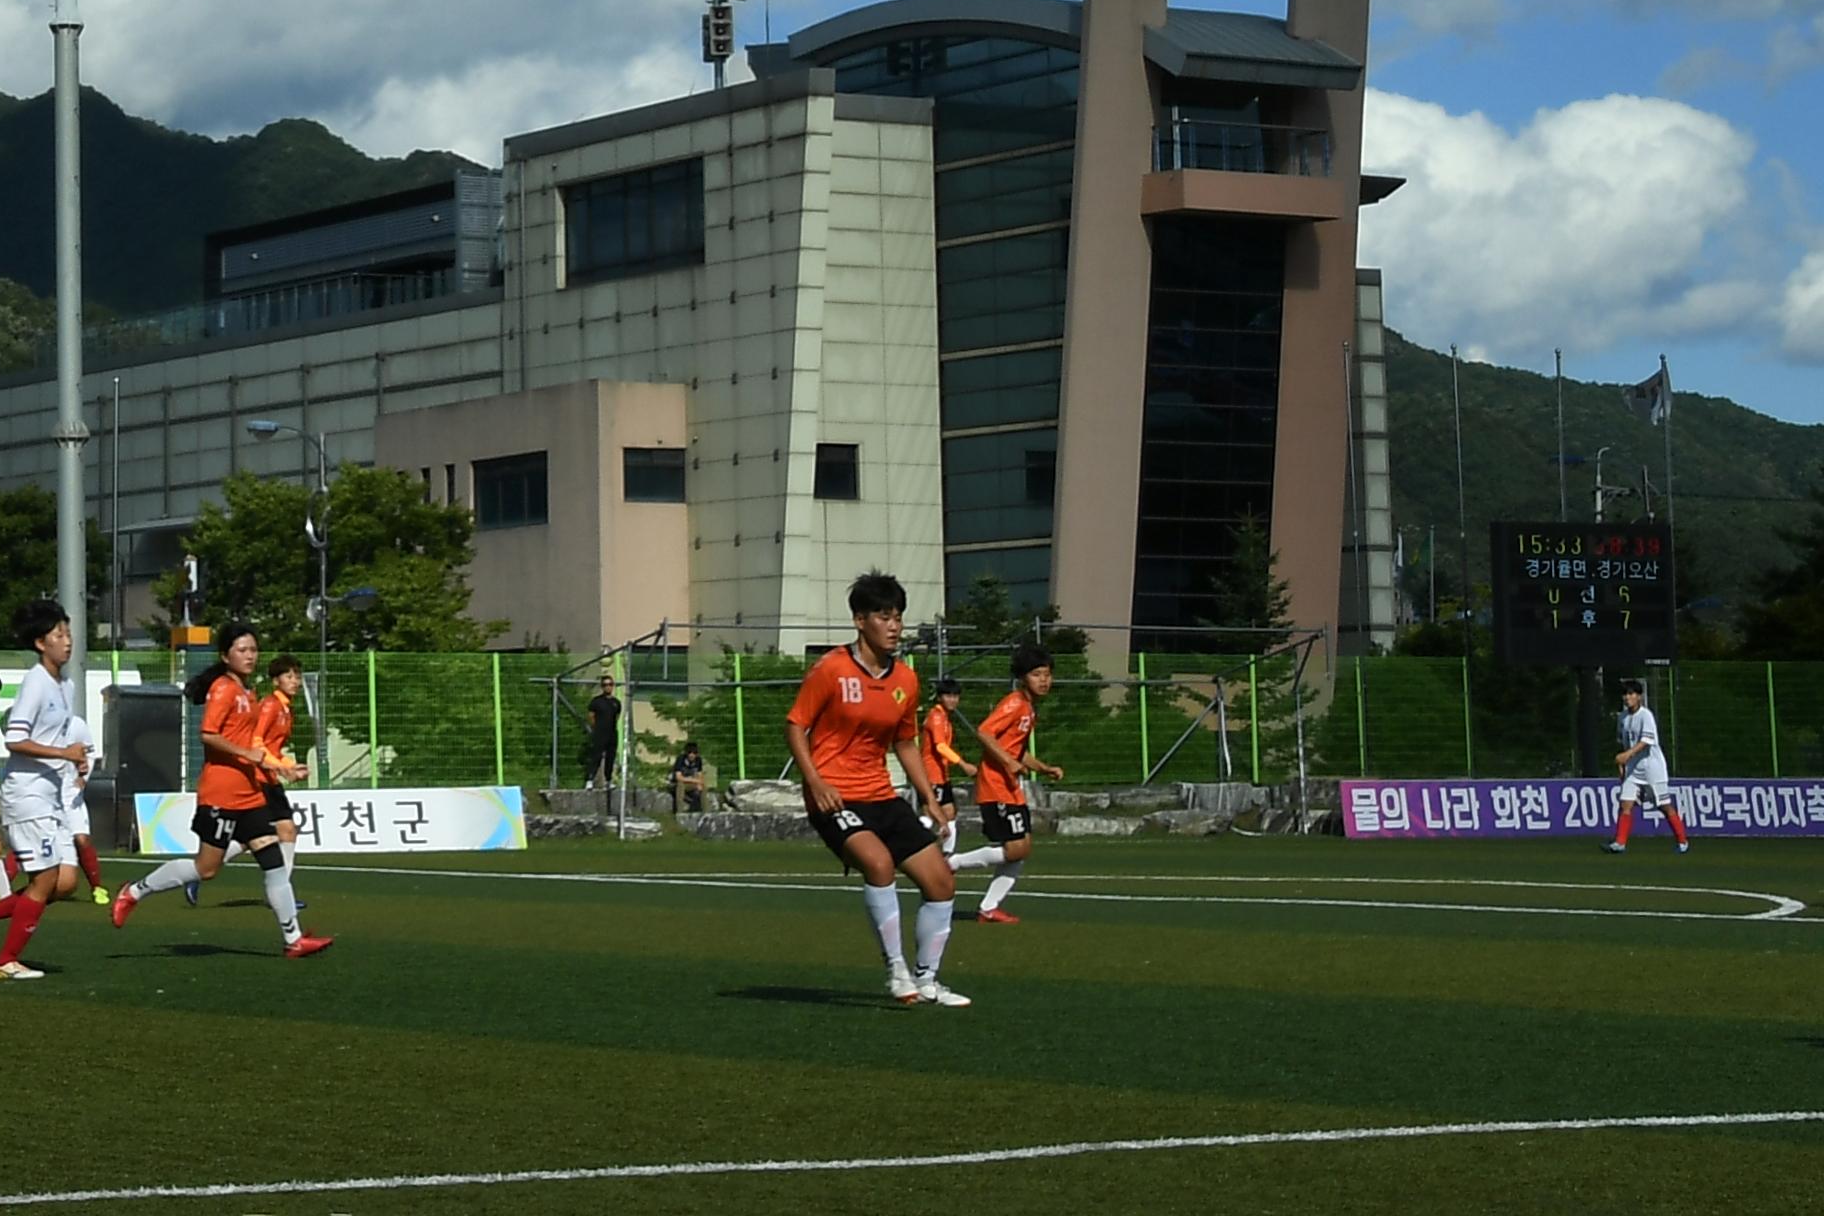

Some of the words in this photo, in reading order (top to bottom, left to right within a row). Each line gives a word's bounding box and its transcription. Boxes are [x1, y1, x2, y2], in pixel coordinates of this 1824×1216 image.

[1517, 534, 1582, 554] 15:33
[1597, 560, 1660, 580] 경기오산
[1620, 610, 1631, 630] 7
[837, 677, 864, 703] 18
[1350, 786, 1410, 831] 물의
[1421, 786, 1481, 830] 나라
[1490, 784, 1552, 830] 화천
[215, 818, 236, 840] 14
[834, 810, 864, 831] 18
[1006, 812, 1025, 834] 12
[41, 839, 53, 858] 5
